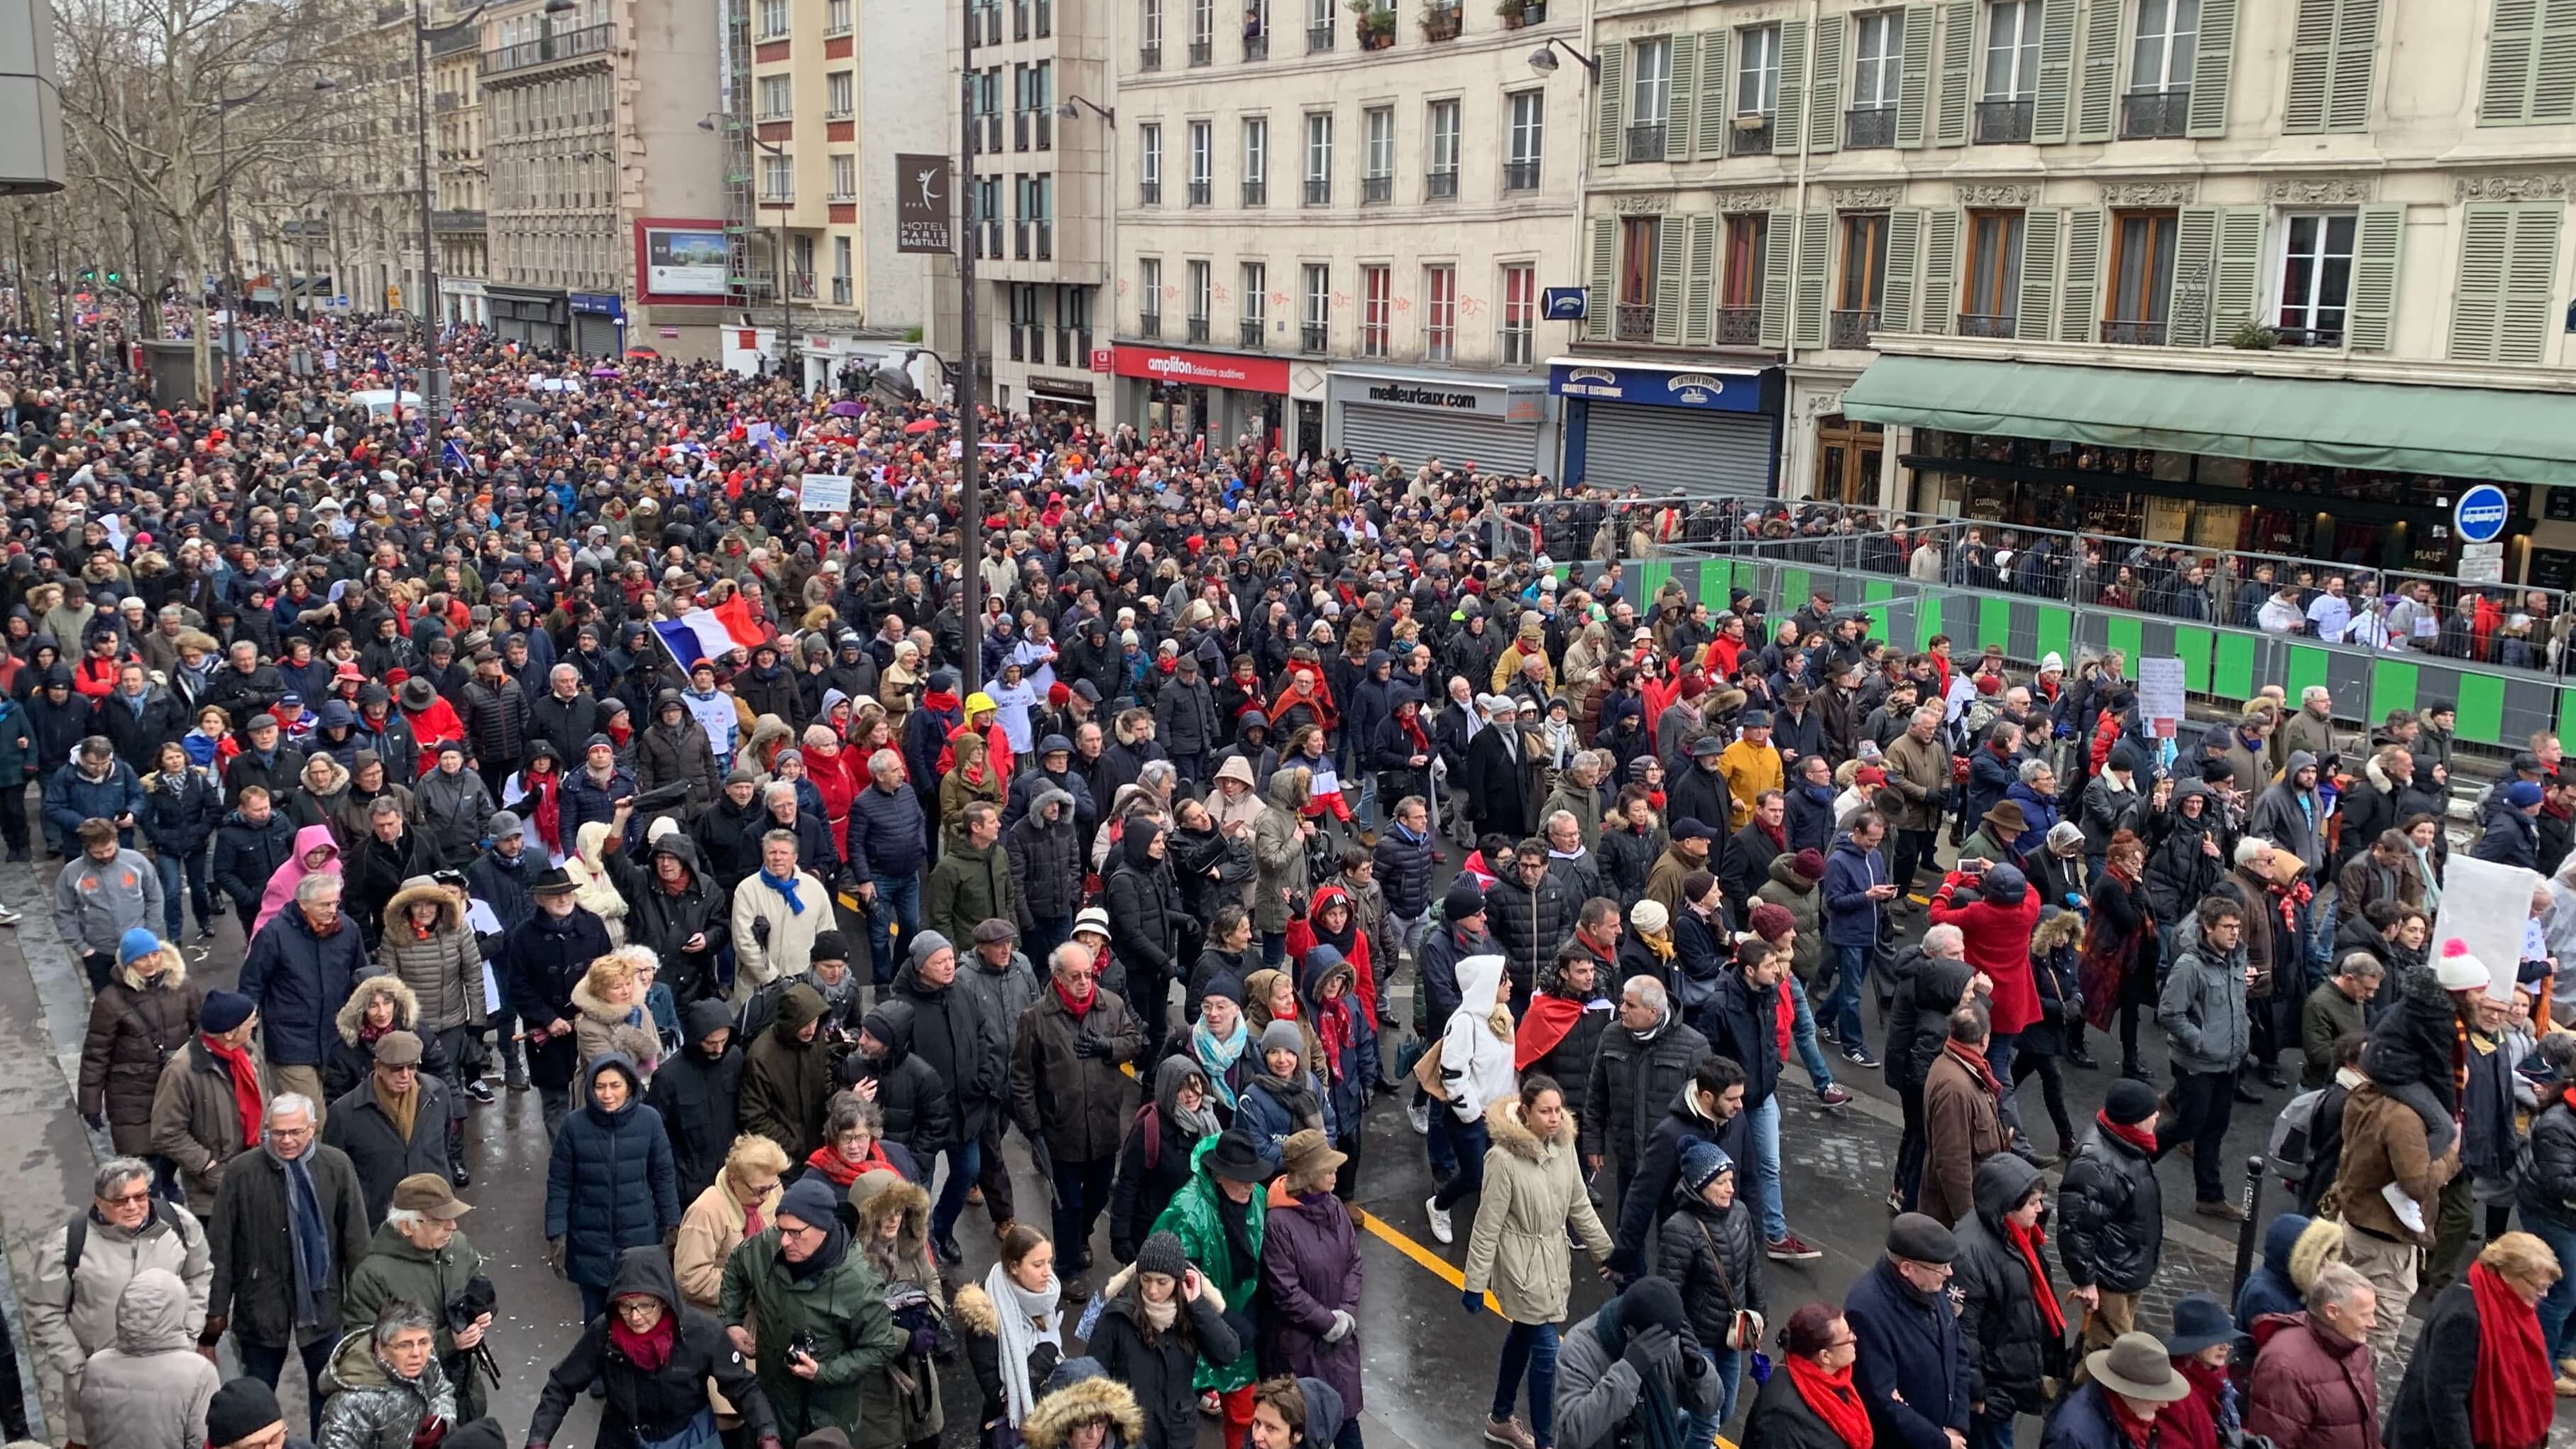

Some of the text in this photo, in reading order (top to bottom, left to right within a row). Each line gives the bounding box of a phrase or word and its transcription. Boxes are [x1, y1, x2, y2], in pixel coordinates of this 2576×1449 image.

[901, 221, 948, 231] HOTEL
[901, 239, 948, 247] BASTILLE
[1148, 354, 1245, 381] amplifon Solutions auditives
[1561, 383, 1586, 394] CIGARETTE
[1675, 374, 1696, 386] BATEAU
[1701, 376, 1721, 392] VAPEUR
[1369, 384, 1476, 409] meilleurtaux.com
[1975, 497, 2001, 509] CUISINE
[2272, 532, 2292, 545] VINS
[2414, 549, 2443, 563] PLATS
